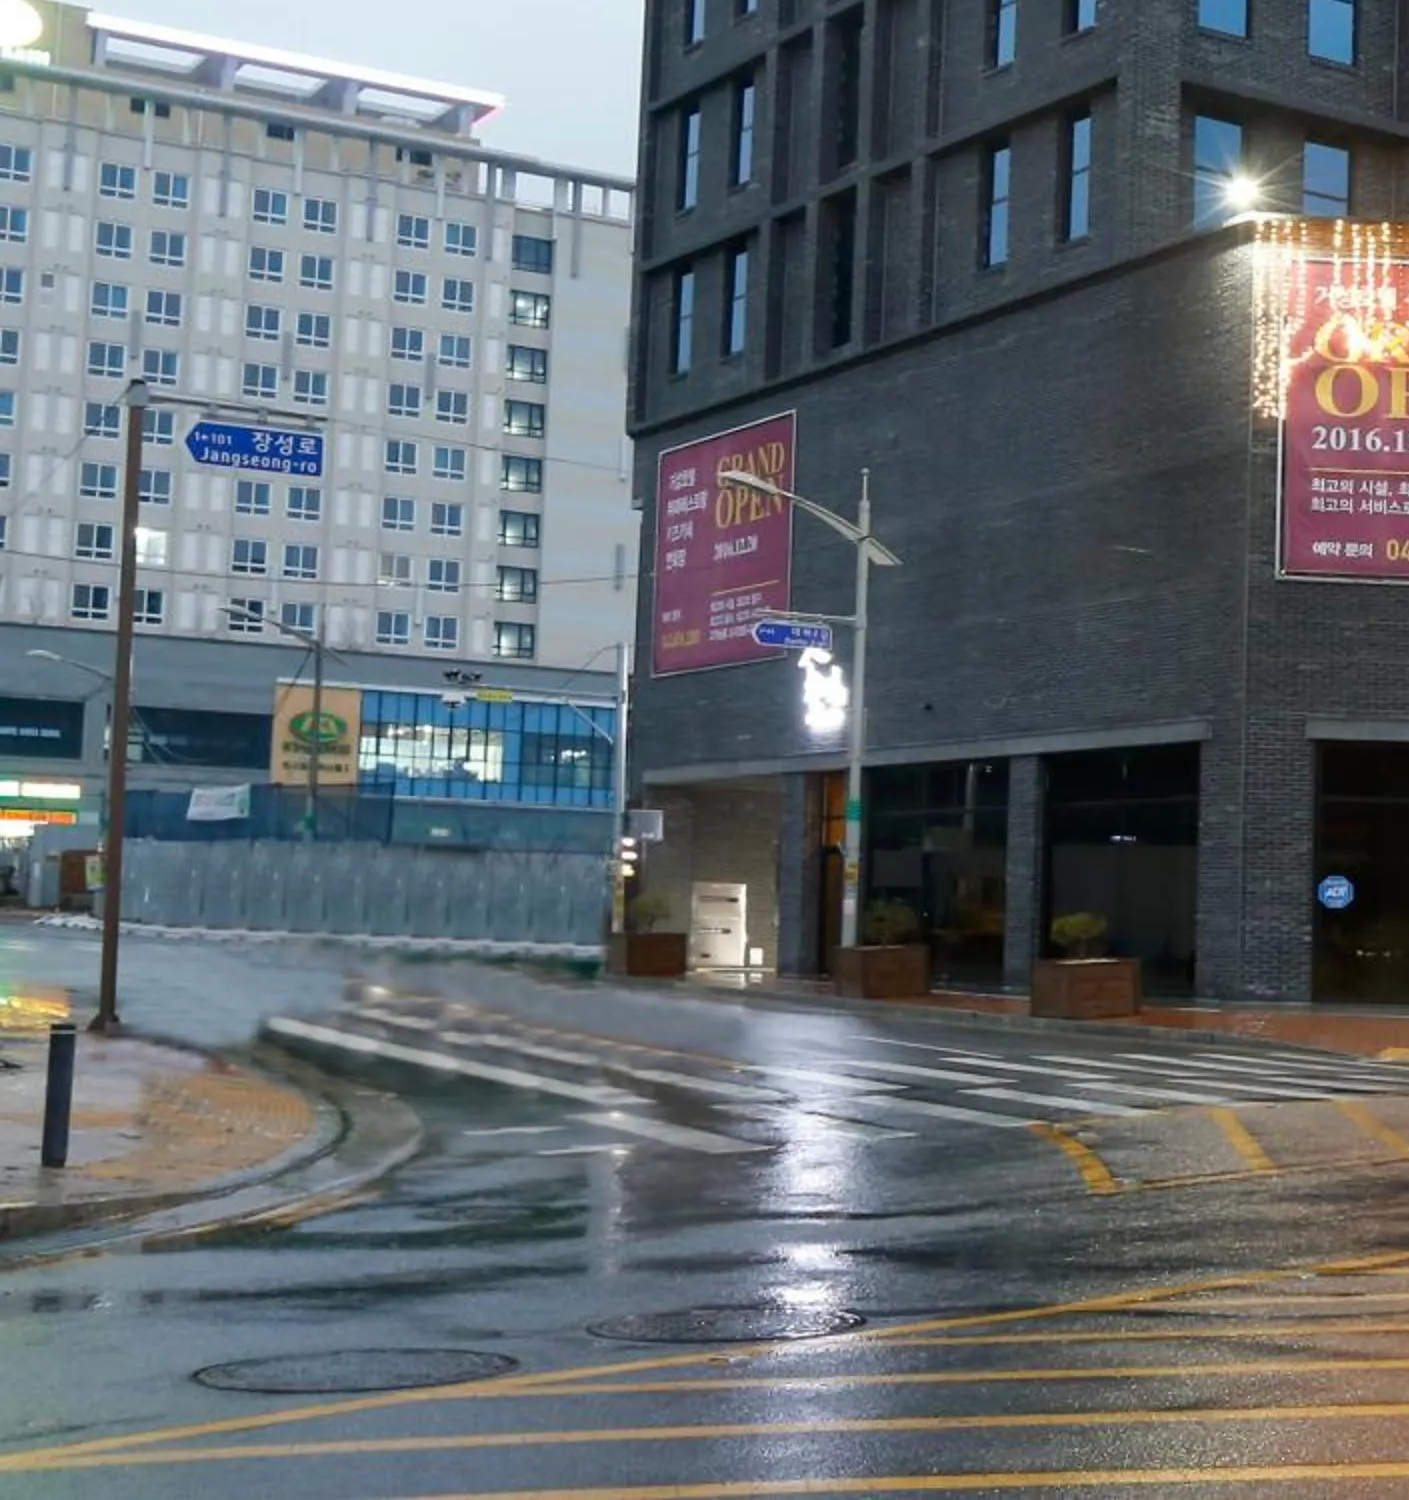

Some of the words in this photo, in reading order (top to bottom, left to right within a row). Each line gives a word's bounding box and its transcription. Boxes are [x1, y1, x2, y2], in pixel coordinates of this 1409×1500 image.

[251, 431, 319, 456] 장성로
[200, 447, 318, 473] Jangseong-ro
[1312, 478, 1354, 495] 최고의
[715, 474, 785, 529] OPEN
[1312, 497, 1353, 514] 최고의
